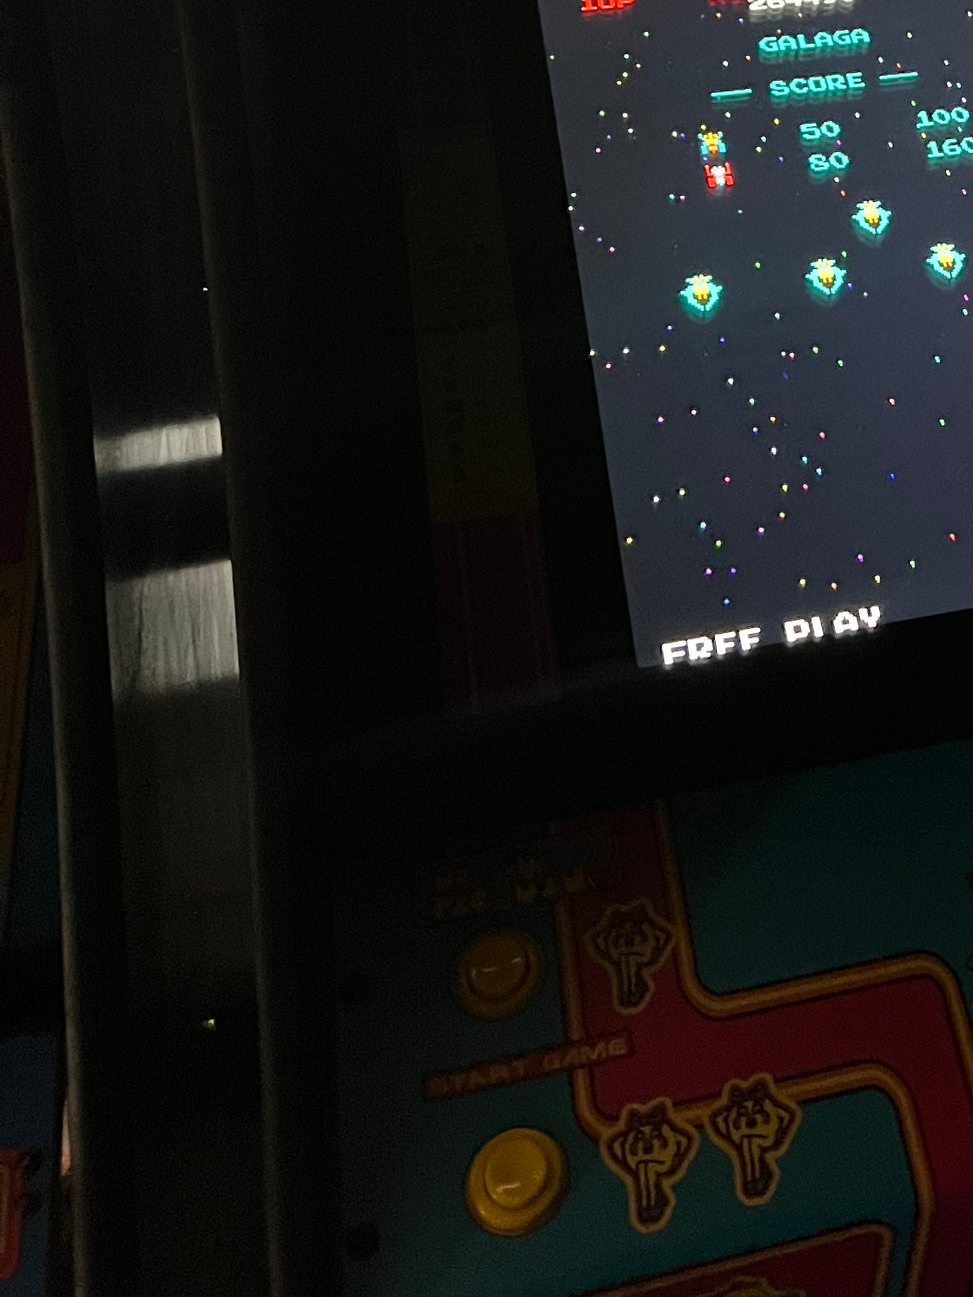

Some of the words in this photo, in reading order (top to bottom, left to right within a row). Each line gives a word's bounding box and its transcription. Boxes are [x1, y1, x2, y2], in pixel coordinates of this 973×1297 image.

[758, 27, 872, 53] GALAGA
[769, 70, 867, 96] SCORE
[799, 120, 842, 140] 50
[915, 105, 972, 130] 100
[807, 151, 851, 172] 80
[426, 1060, 528, 1096] START
[541, 1035, 631, 1070] GAME
